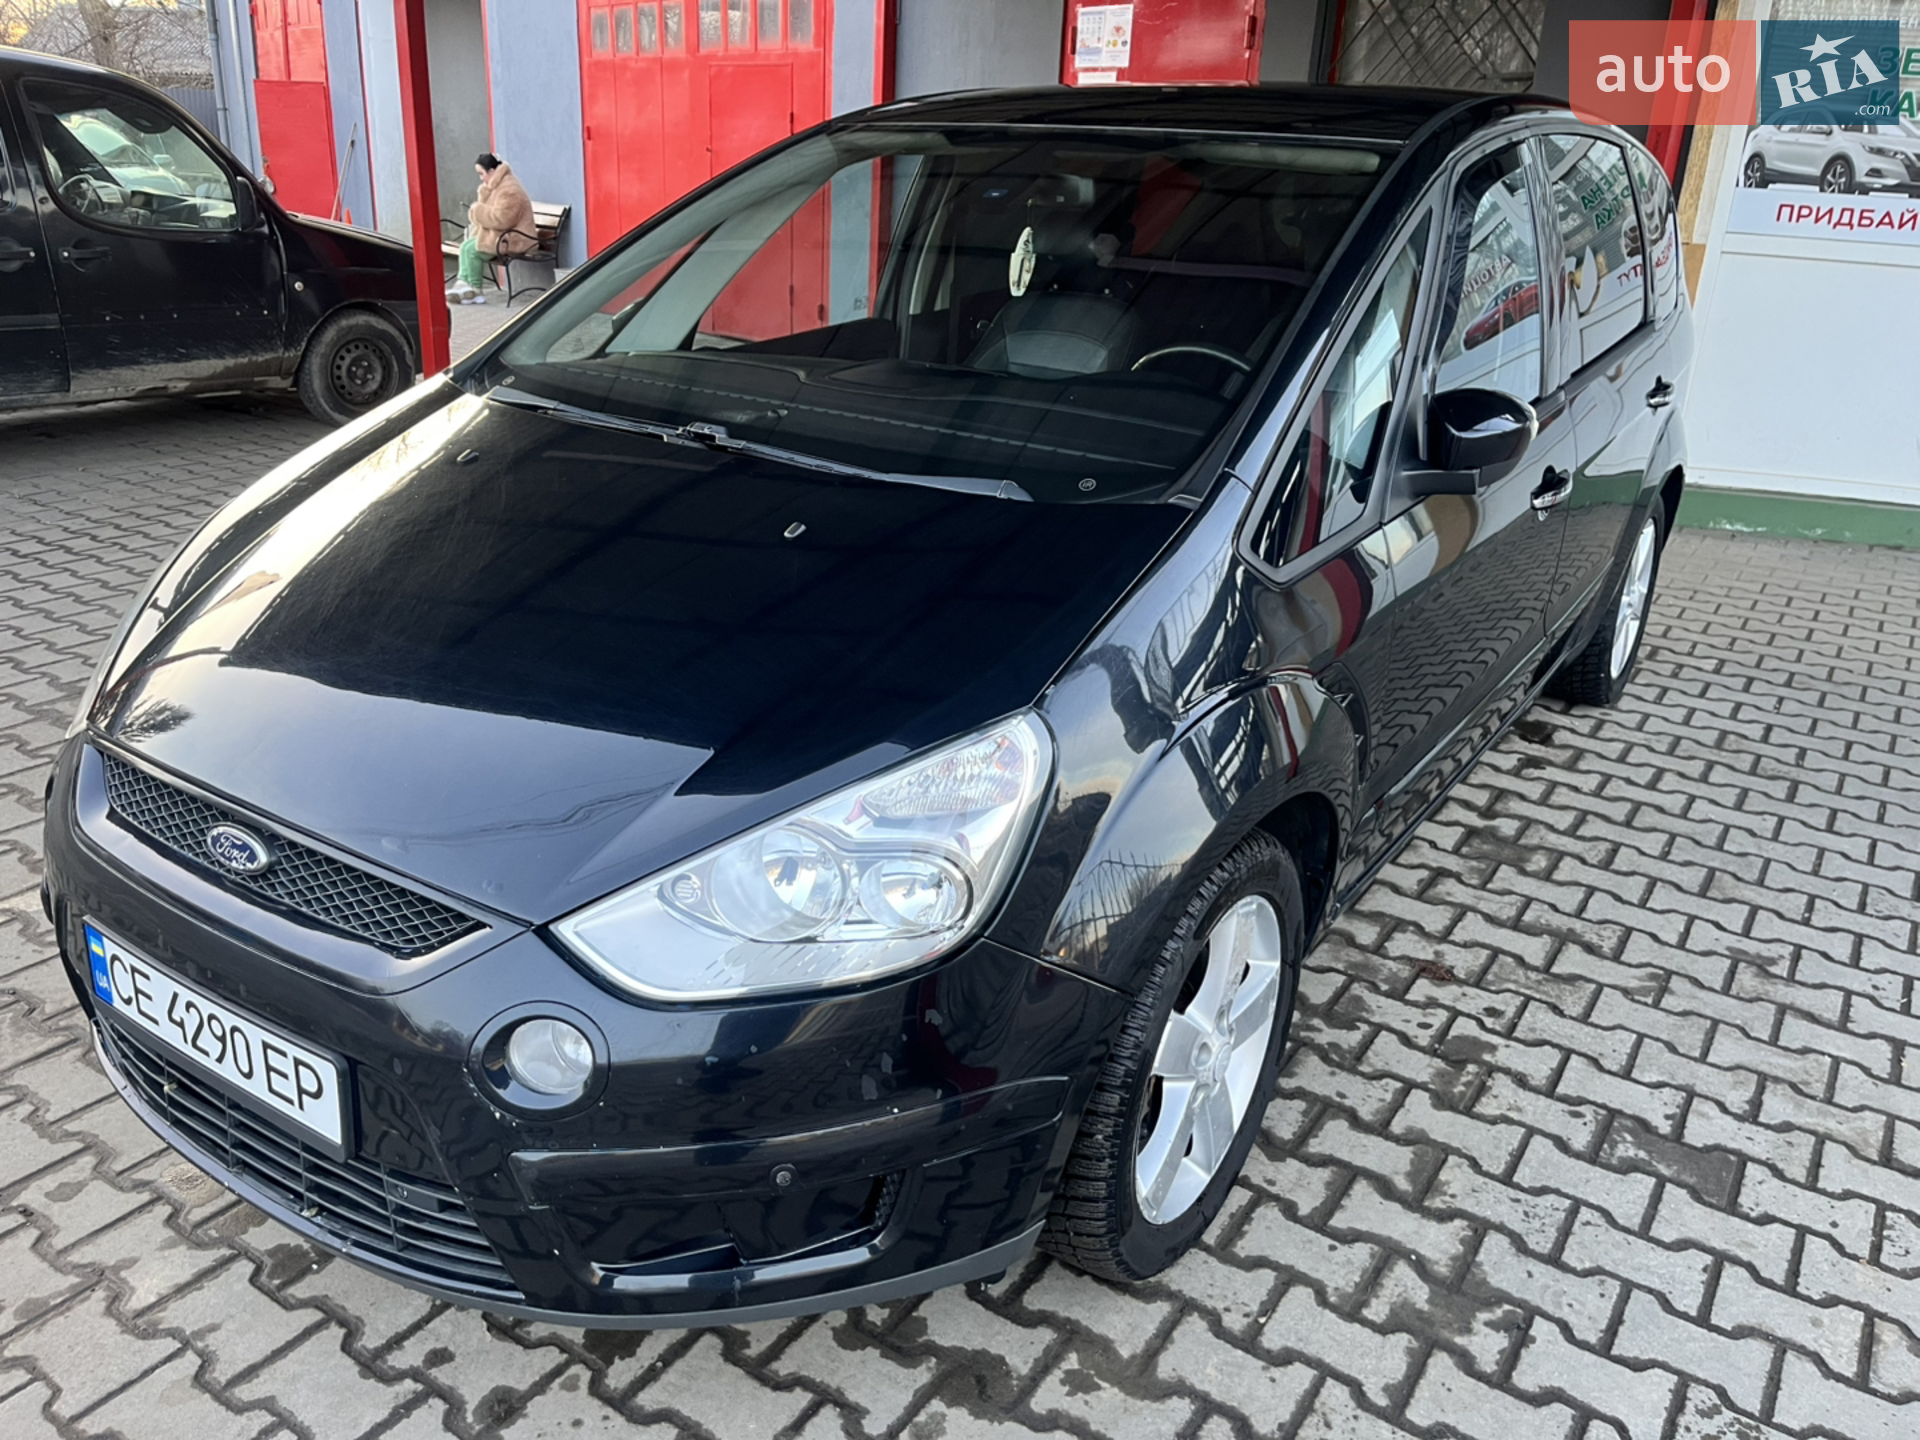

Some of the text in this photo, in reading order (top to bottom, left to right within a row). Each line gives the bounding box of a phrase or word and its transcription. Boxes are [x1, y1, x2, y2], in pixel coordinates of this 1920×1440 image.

[1776, 203, 1919, 231] ПРИДБАЙ
[215, 834, 250, 864] Ford
[95, 970, 111, 992] UA
[109, 953, 323, 1111] CE 4290 EP
